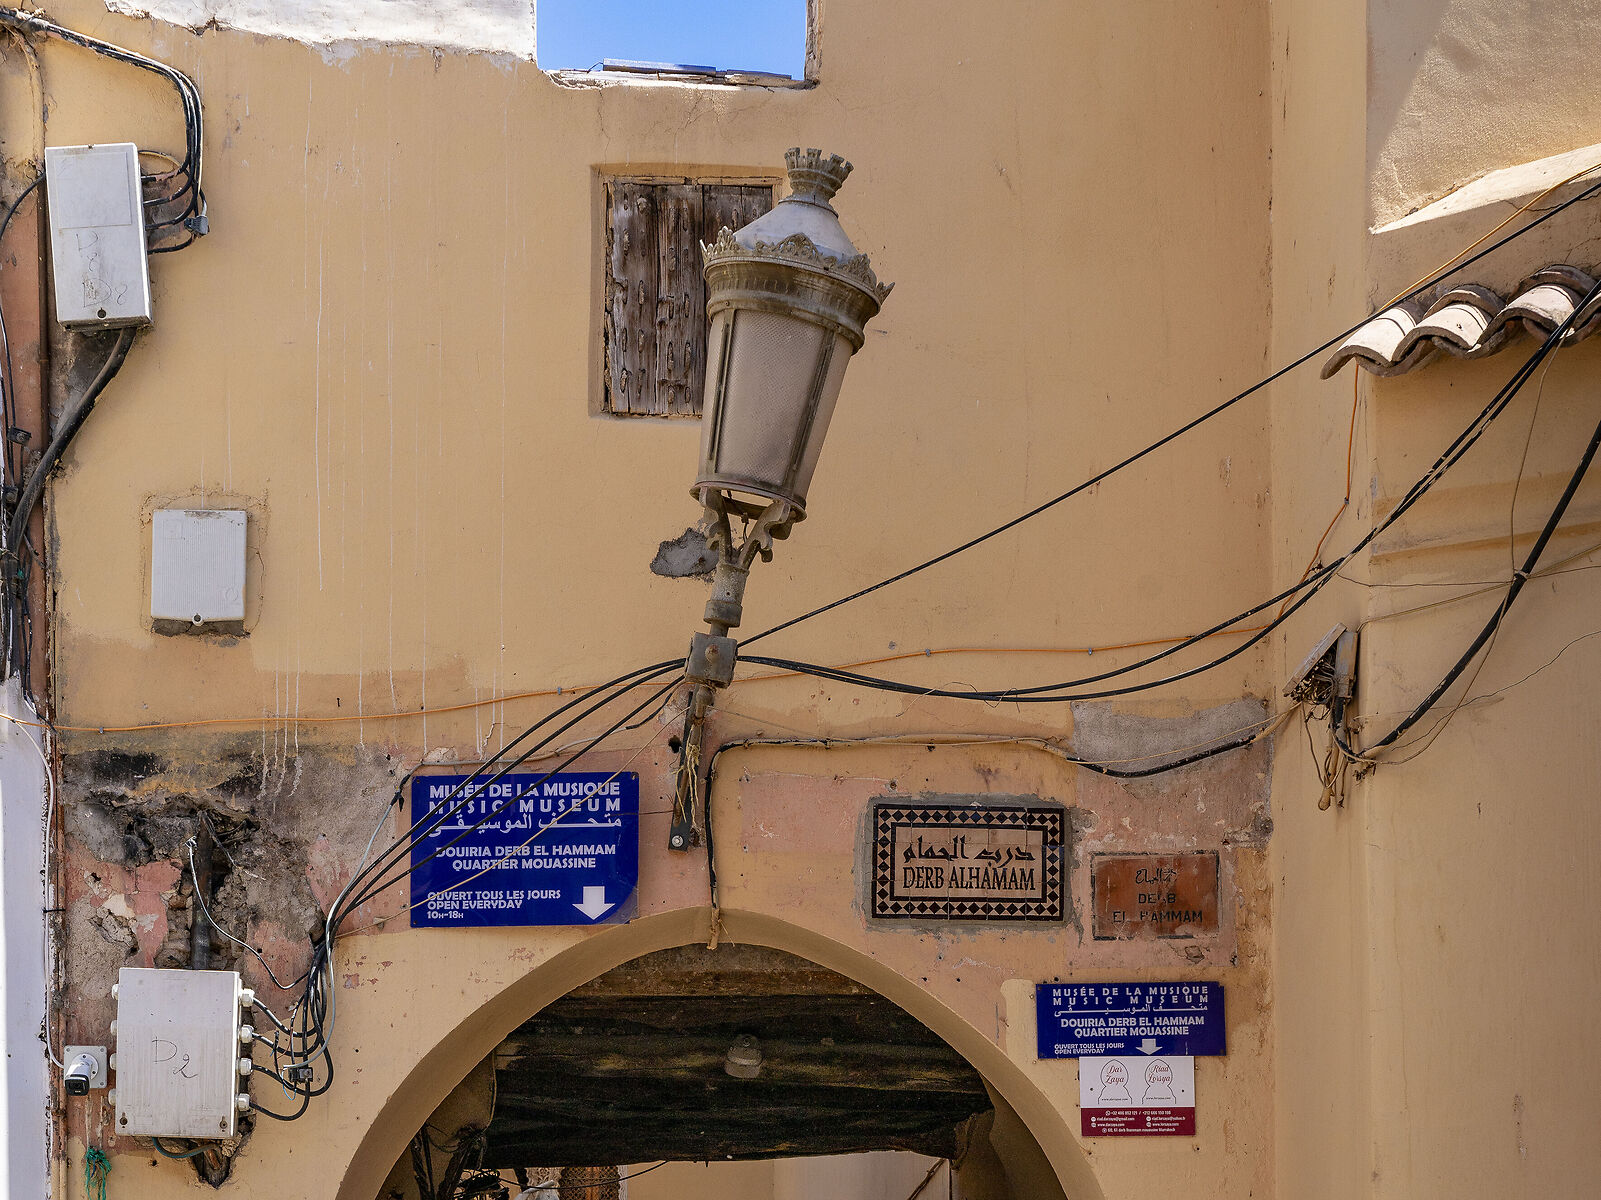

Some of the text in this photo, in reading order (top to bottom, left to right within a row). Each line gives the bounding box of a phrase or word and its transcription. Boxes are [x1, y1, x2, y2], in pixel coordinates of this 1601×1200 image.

[489, 784, 512, 797] DE
[516, 783, 539, 797] LA
[543, 782, 620, 797] MUSIQUE
[519, 798, 620, 812] MUSEUM
[436, 844, 616, 858] DOUIRIA DERB EL HAMMAM
[903, 835, 1036, 869] درب الحمام
[452, 858, 596, 872] QUARTIER MOUASSINE
[903, 866, 1036, 890] DERB ALHAMAM
[427, 890, 561, 900] OUVERT TOUS LES JOURS
[427, 900, 523, 910] OPEN EVERYDAY
[1052, 986, 1208, 997] MUSÉE DE LA MUSIQUE
[1053, 995, 1208, 1006] MUSIC MUSEUM
[1060, 1016, 1204, 1028] DOUIRIA DERB EL HAMMAM
[1074, 1026, 1189, 1038] QUARTIER MOUASSINE
